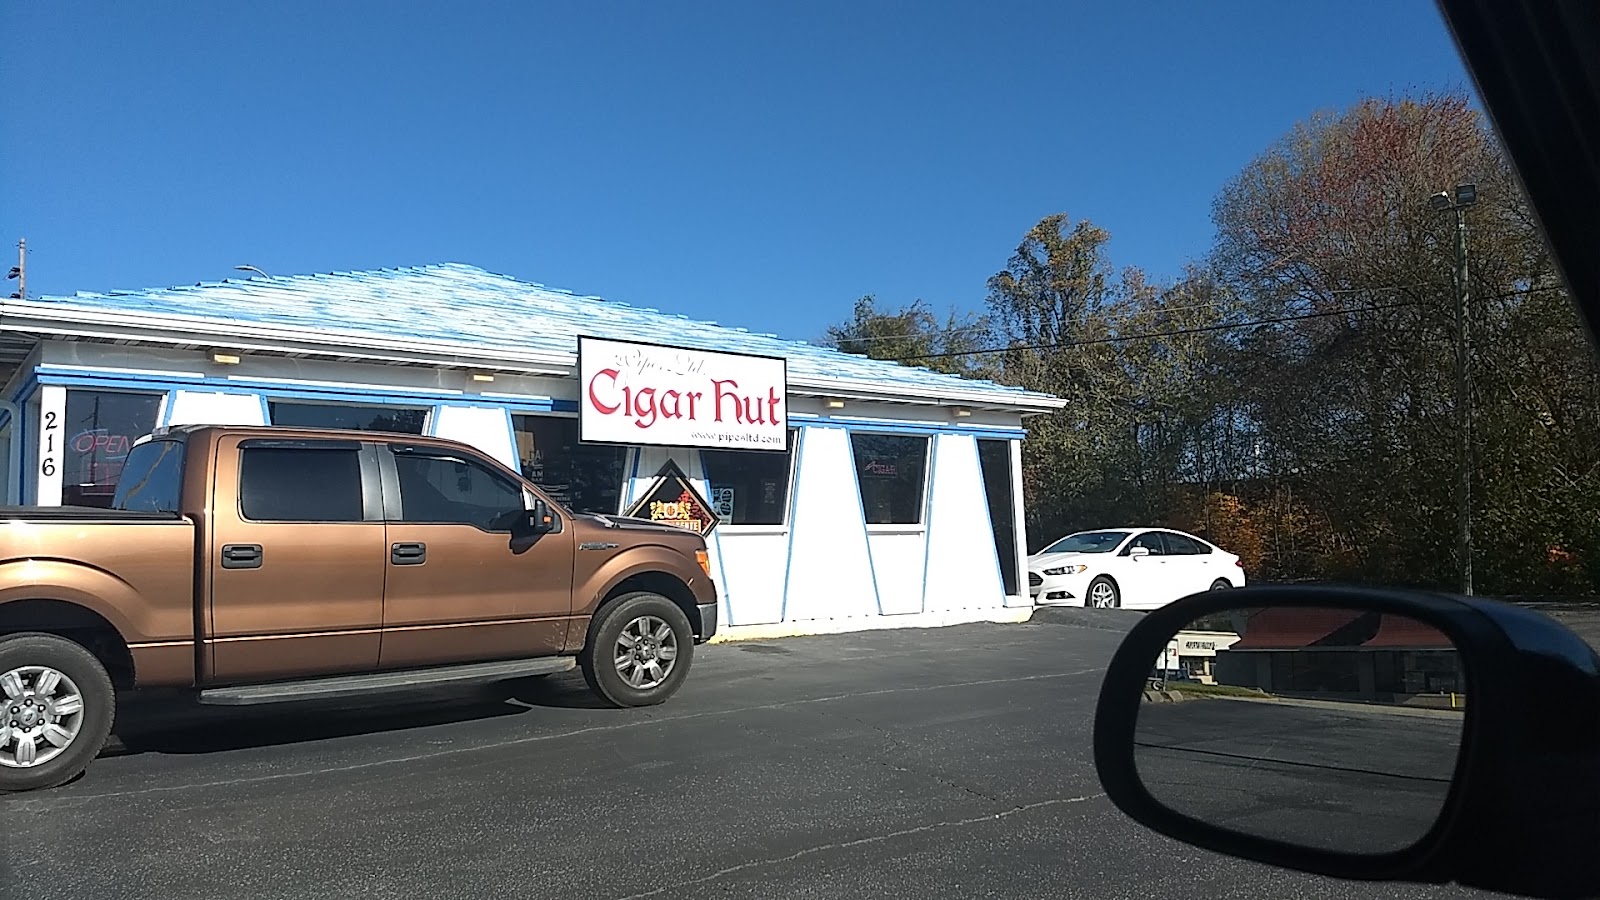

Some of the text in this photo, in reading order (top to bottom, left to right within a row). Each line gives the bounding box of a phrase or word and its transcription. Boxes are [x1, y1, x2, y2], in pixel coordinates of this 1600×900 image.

[588, 368, 781, 428] Cigar Hut
[75, 434, 137, 453] OPEN
